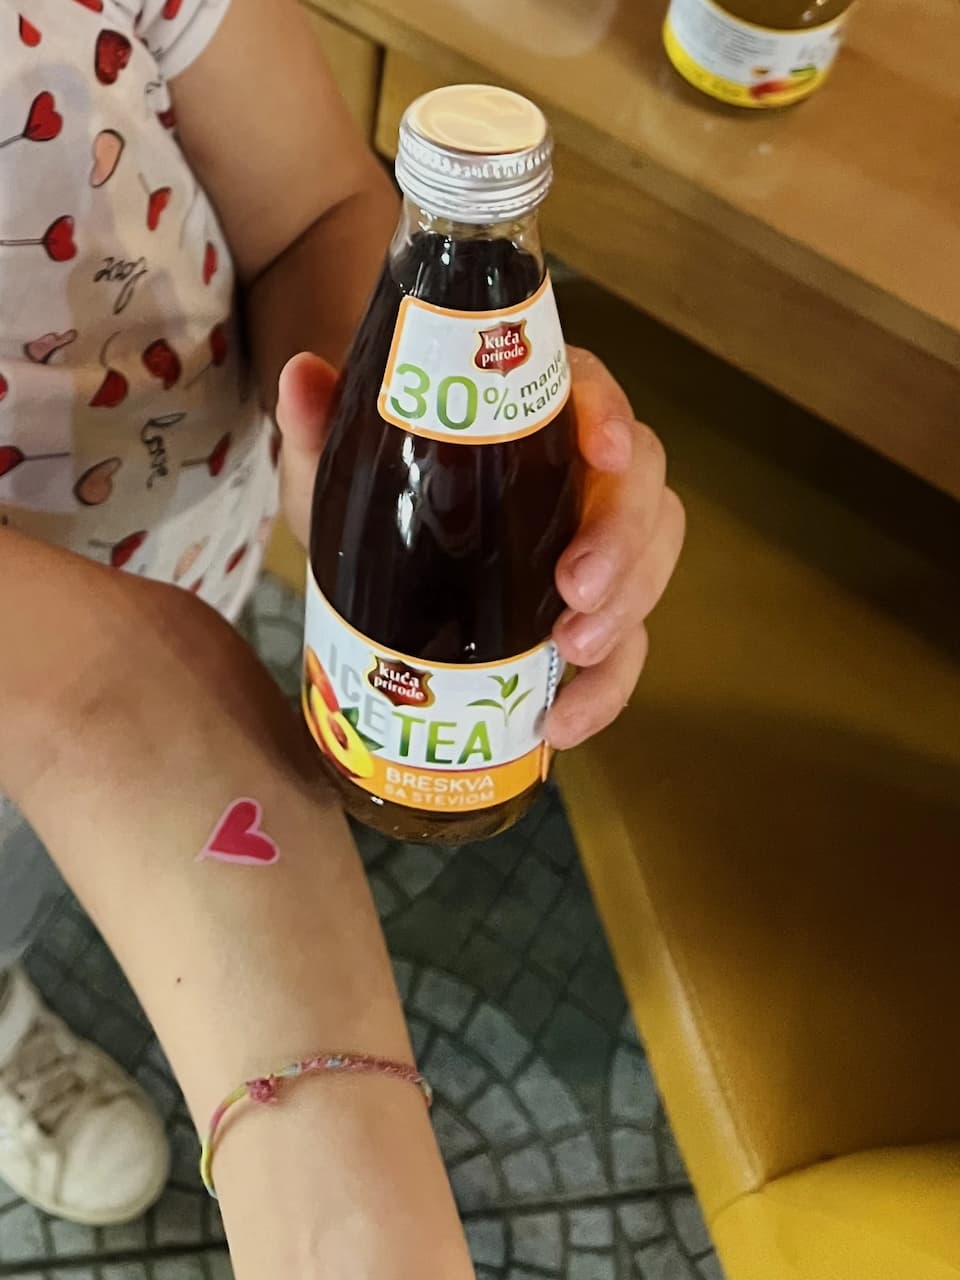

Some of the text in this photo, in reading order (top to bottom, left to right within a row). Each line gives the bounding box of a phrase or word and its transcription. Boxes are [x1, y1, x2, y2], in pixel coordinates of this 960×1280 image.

[92, 256, 148, 316] love
[483, 330, 520, 350] kuća
[480, 344, 525, 368] prirode
[390, 362, 519, 431] 30%
[378, 660, 421, 688] kuća
[373, 676, 426, 701] prirode
[328, 642, 493, 766] ICE TEA
[385, 766, 495, 793] BRESKVA
